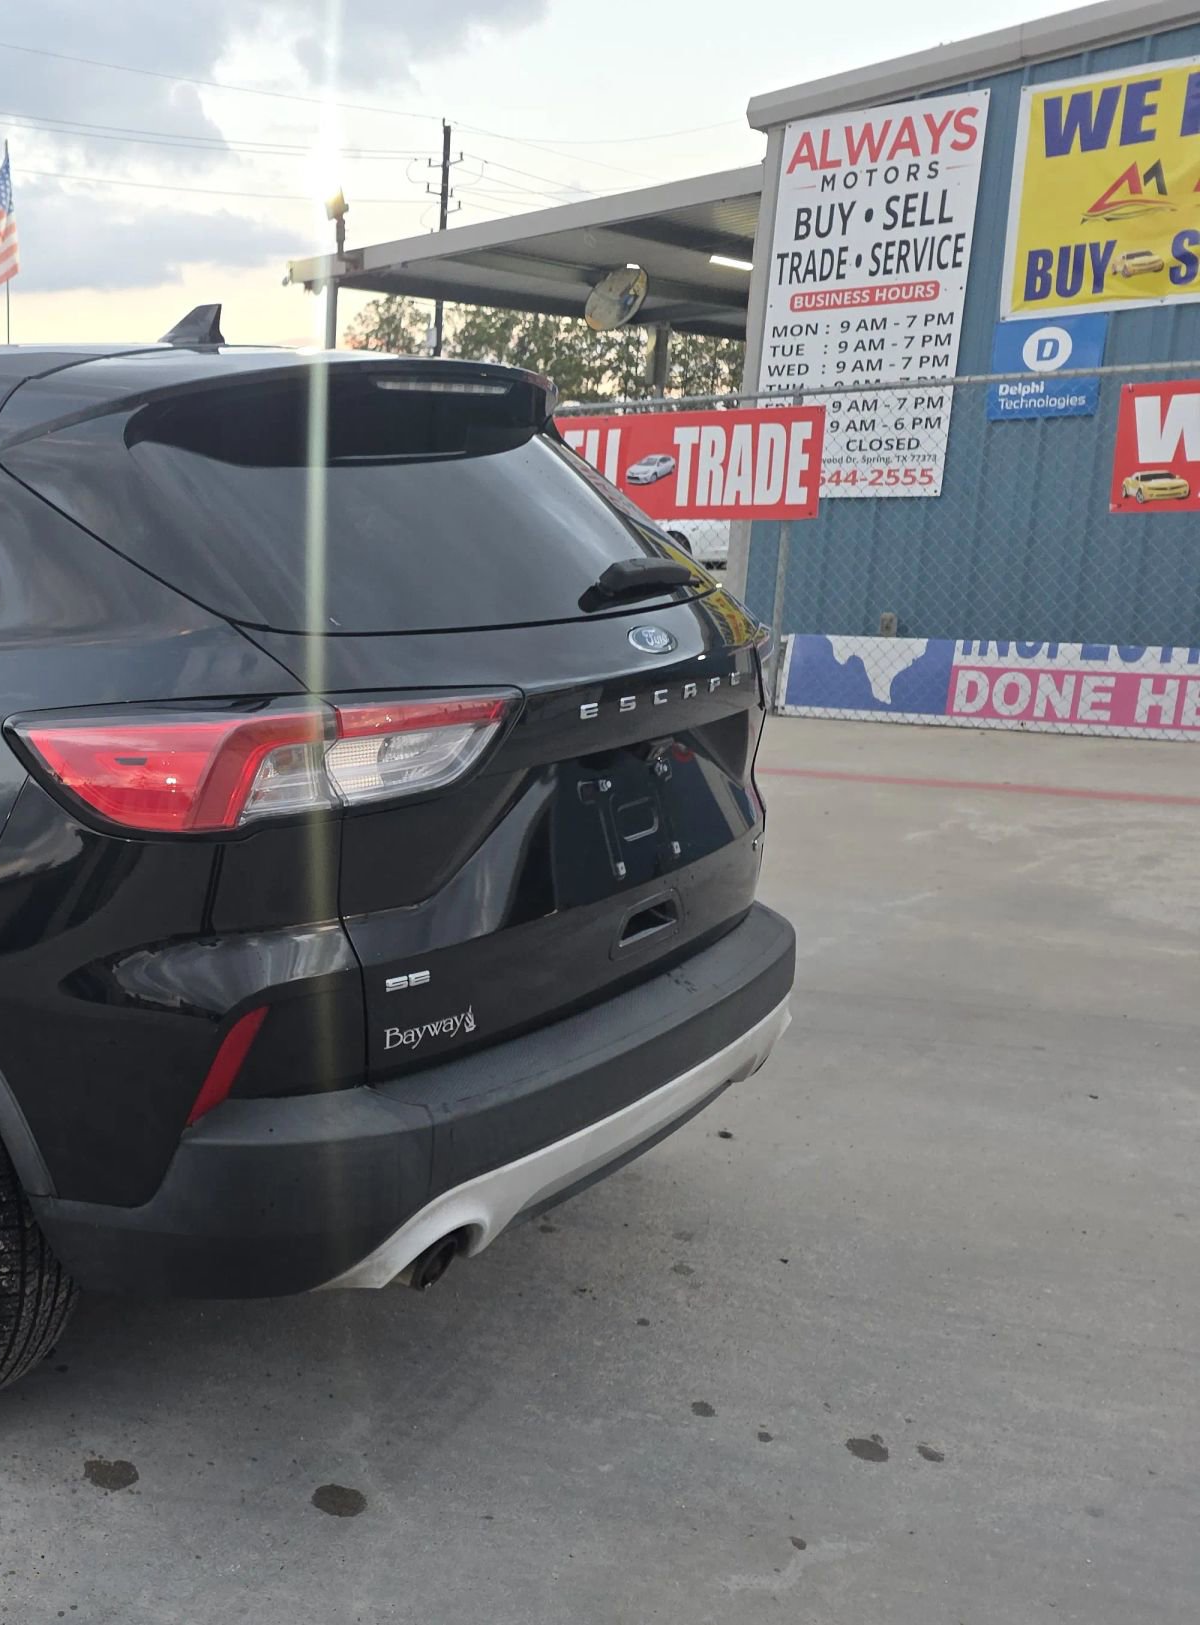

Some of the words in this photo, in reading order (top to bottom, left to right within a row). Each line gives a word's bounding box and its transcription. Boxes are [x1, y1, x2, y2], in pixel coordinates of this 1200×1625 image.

[1044, 78, 1162, 158] WE
[786, 107, 979, 175] ALWAYS
[820, 160, 940, 192] MOTORS
[794, 200, 857, 241] BUY
[882, 189, 954, 231] SELL
[776, 246, 849, 286] TRADE
[868, 233, 966, 277] SERVICE
[1023, 239, 1118, 302] BUY
[793, 290, 870, 309] BUSINESS
[874, 283, 936, 302] HOURS
[772, 323, 819, 338] MON
[840, 320, 851, 334] 9
[855, 317, 888, 332] AM
[906, 315, 918, 328] 7
[924, 311, 955, 327] PM
[769, 344, 805, 358] TUE
[838, 340, 848, 354] 9
[853, 337, 885, 352] AM
[903, 335, 915, 349] 7
[921, 333, 952, 348] PM
[767, 363, 810, 377] WED
[836, 360, 846, 374] 9
[851, 358, 883, 373] AM
[901, 356, 912, 370] 7
[919, 354, 950, 368] PM
[998, 381, 1045, 397] Delphi
[998, 395, 1086, 410] Technologies
[832, 400, 842, 413] 9
[846, 399, 878, 412] AM
[897, 398, 908, 411] 7
[913, 395, 944, 410] PM
[830, 420, 840, 433] 9
[845, 419, 876, 432] AM
[894, 417, 905, 430] 6
[911, 416, 942, 430] PM
[845, 437, 920, 452] CLOSED
[673, 421, 813, 507] TRADE
[579, 671, 741, 720] ESCAPE
[952, 669, 1116, 721] DONE
[385, 970, 431, 992] SE
[384, 1013, 465, 1050] Bayway
